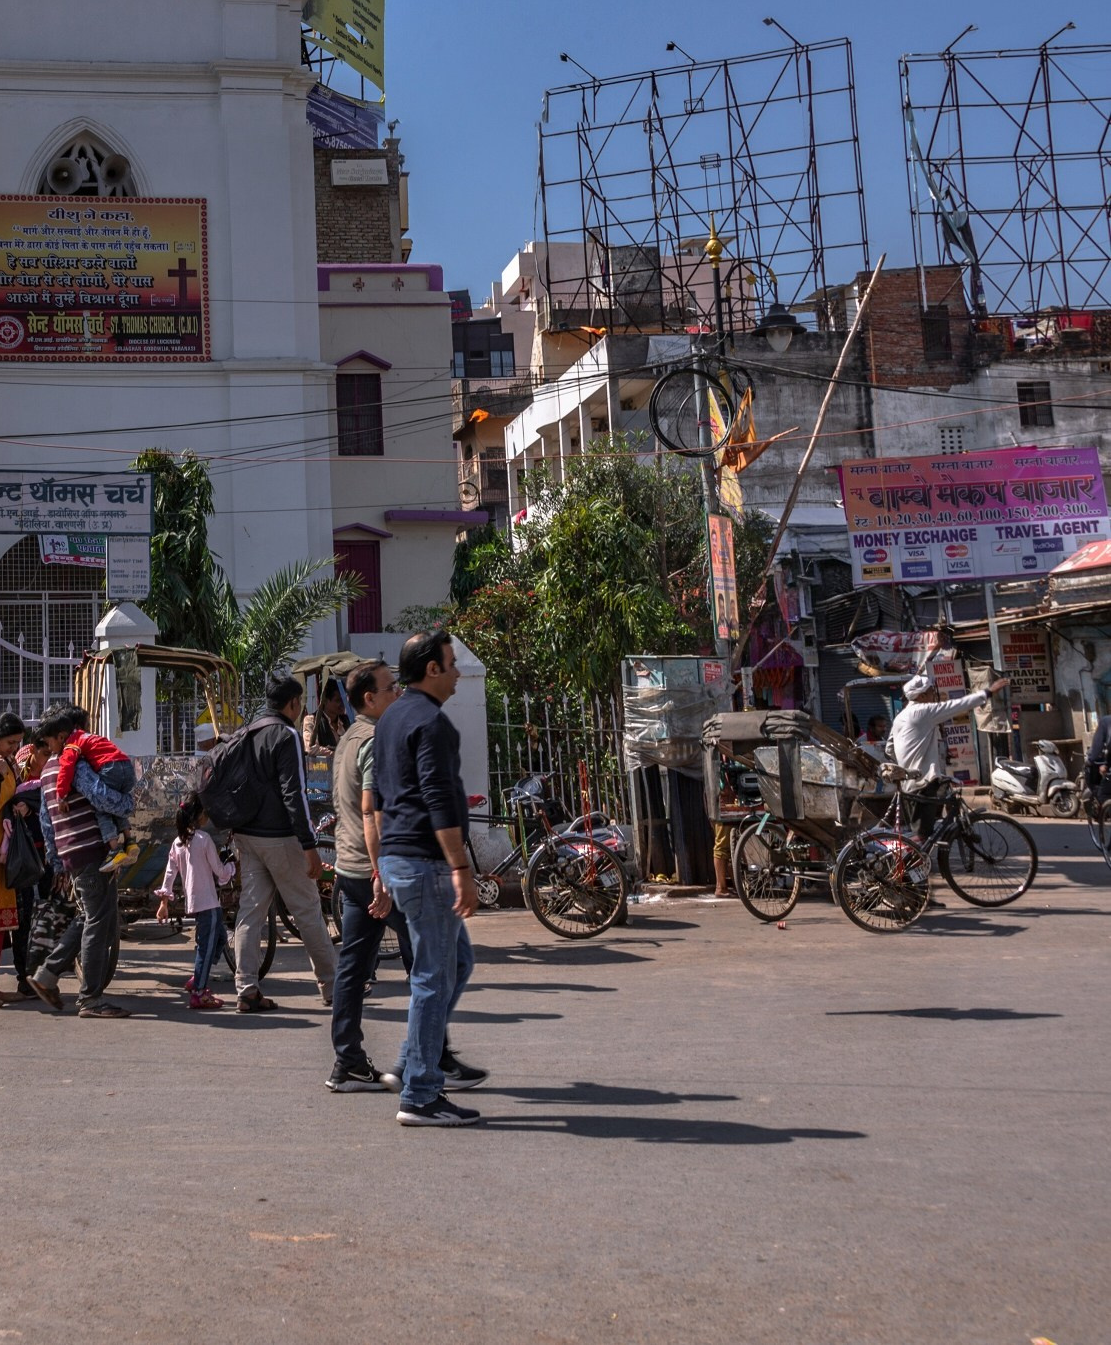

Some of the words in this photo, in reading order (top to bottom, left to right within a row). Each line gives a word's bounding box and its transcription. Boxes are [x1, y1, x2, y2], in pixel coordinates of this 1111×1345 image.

[47, 207, 80, 224] यीशु
[83, 208, 97, 221] ने
[40, 225, 56, 238] और
[84, 225, 99, 238] और
[100, 226, 121, 238] जीवन
[131, 226, 141, 237] ही
[14, 238, 25, 250] मेरे
[44, 239, 59, 251] कोई
[61, 239, 79, 251] पिता
[81, 240, 89, 251] के
[90, 242, 106, 252] पास
[107, 240, 122, 252] नहीं
[6, 252, 18, 270] हे
[18, 256, 39, 270] सब
[40, 253, 79, 270] परिश्रम
[79, 253, 107, 270] करने
[107, 254, 137, 271] वालों
[15, 271, 41, 287] बोझ
[41, 271, 55, 287] से
[55, 271, 75, 287] दबे
[111, 271, 129, 288] मेरे
[129, 275, 154, 288] पास
[6, 290, 38, 304] आओ
[54, 289, 76, 307] तुम्हें
[78, 290, 116, 305] विश्राम
[118, 290, 140, 308] दूँगा
[27, 311, 50, 334] सेन्ट
[53, 311, 84, 334] थॉमस
[86, 311, 105, 334] चर्च
[122, 316, 148, 334] THOMAS
[850, 464, 878, 475] सस्ता
[931, 461, 959, 472] सस्ता
[1015, 457, 1043, 467] सस्ता
[30, 477, 97, 507] थॉमस
[104, 478, 146, 504] चर्च
[1007, 475, 1096, 505] बाजार
[994, 523, 1050, 540] TRAVEL
[1052, 519, 1099, 536] AGENT
[853, 531, 900, 548] MONEY
[904, 528, 978, 546] EXCHANGE
[907, 550, 925, 558] VISA
[950, 561, 970, 569] VISA
[933, 663, 955, 675] MONEY
[1010, 677, 1047, 686] AGENT
